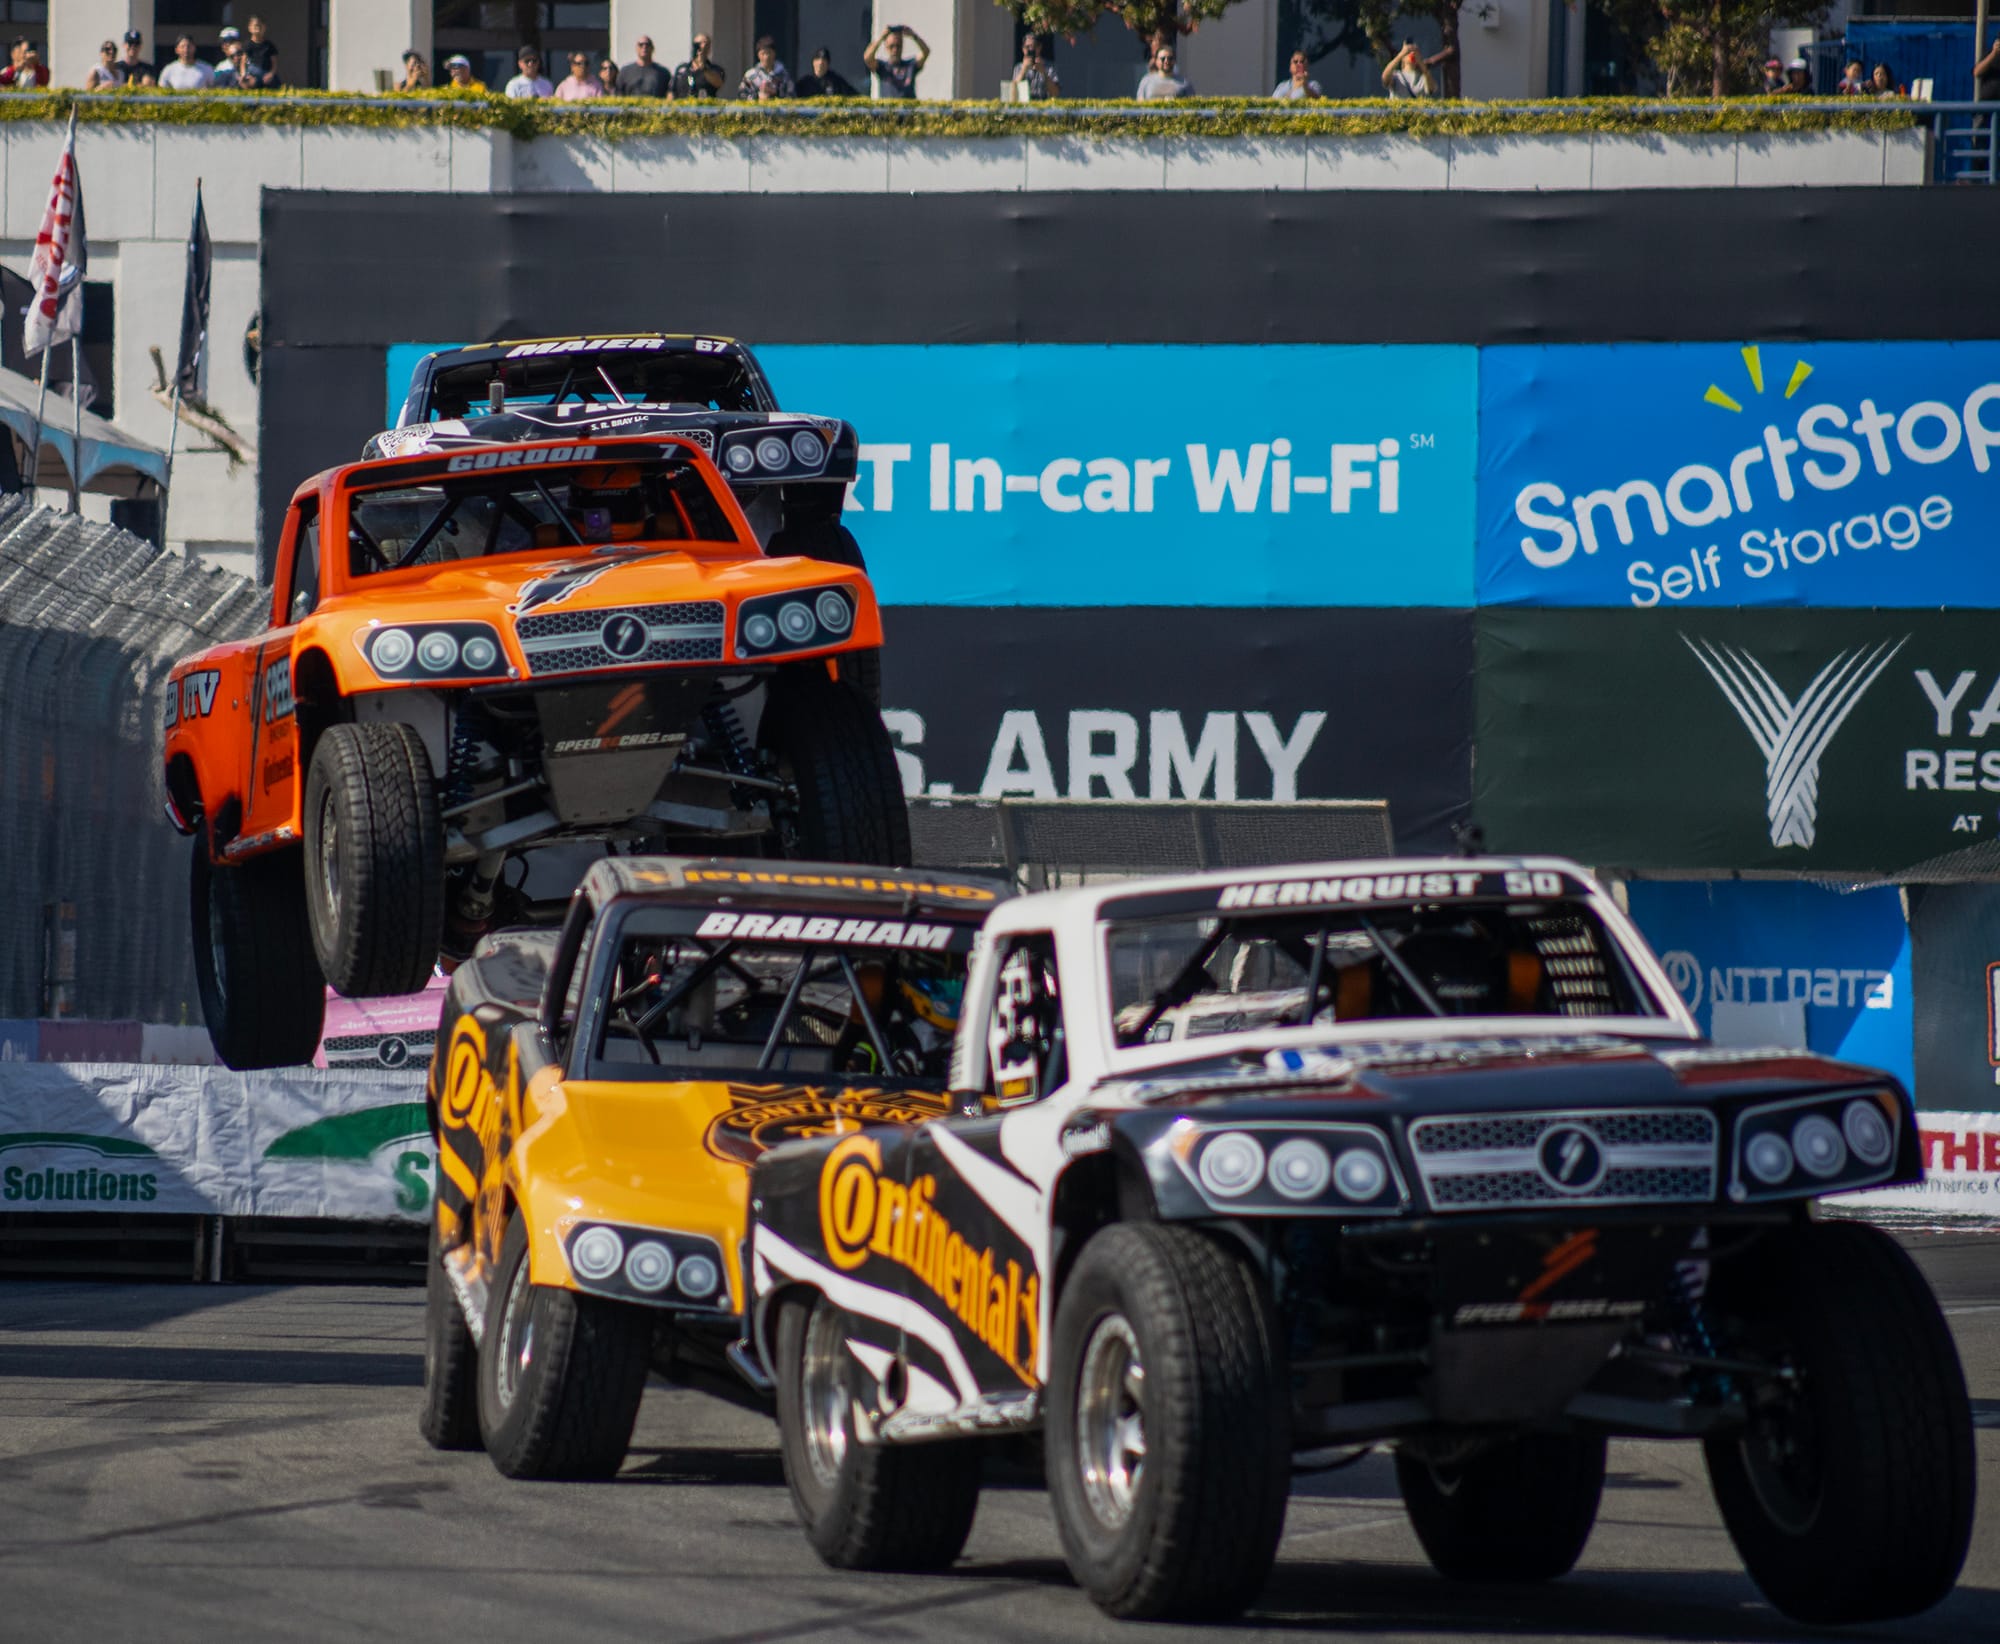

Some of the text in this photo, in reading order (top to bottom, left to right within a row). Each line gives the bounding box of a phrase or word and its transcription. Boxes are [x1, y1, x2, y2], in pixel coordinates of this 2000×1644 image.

[505, 339, 727, 358] MAIER 67
[611, 417, 634, 427] BRAY
[447, 444, 678, 472] GORDON 7
[929, 442, 1171, 512] In-car
[1185, 437, 1401, 513] Wi-Fi
[1409, 433, 1434, 449] SM
[1515, 382, 2000, 569] SmartStop
[1626, 494, 1953, 608] Self Storage
[183, 671, 220, 718] UTV
[978, 709, 1328, 800] ARMY
[1952, 814, 1982, 832] AT
[1216, 870, 1564, 909] HERNQUIST 50
[695, 912, 955, 949] BRABHAM
[1710, 966, 1782, 1006] NTT
[3, 1166, 158, 1201] Solutions
